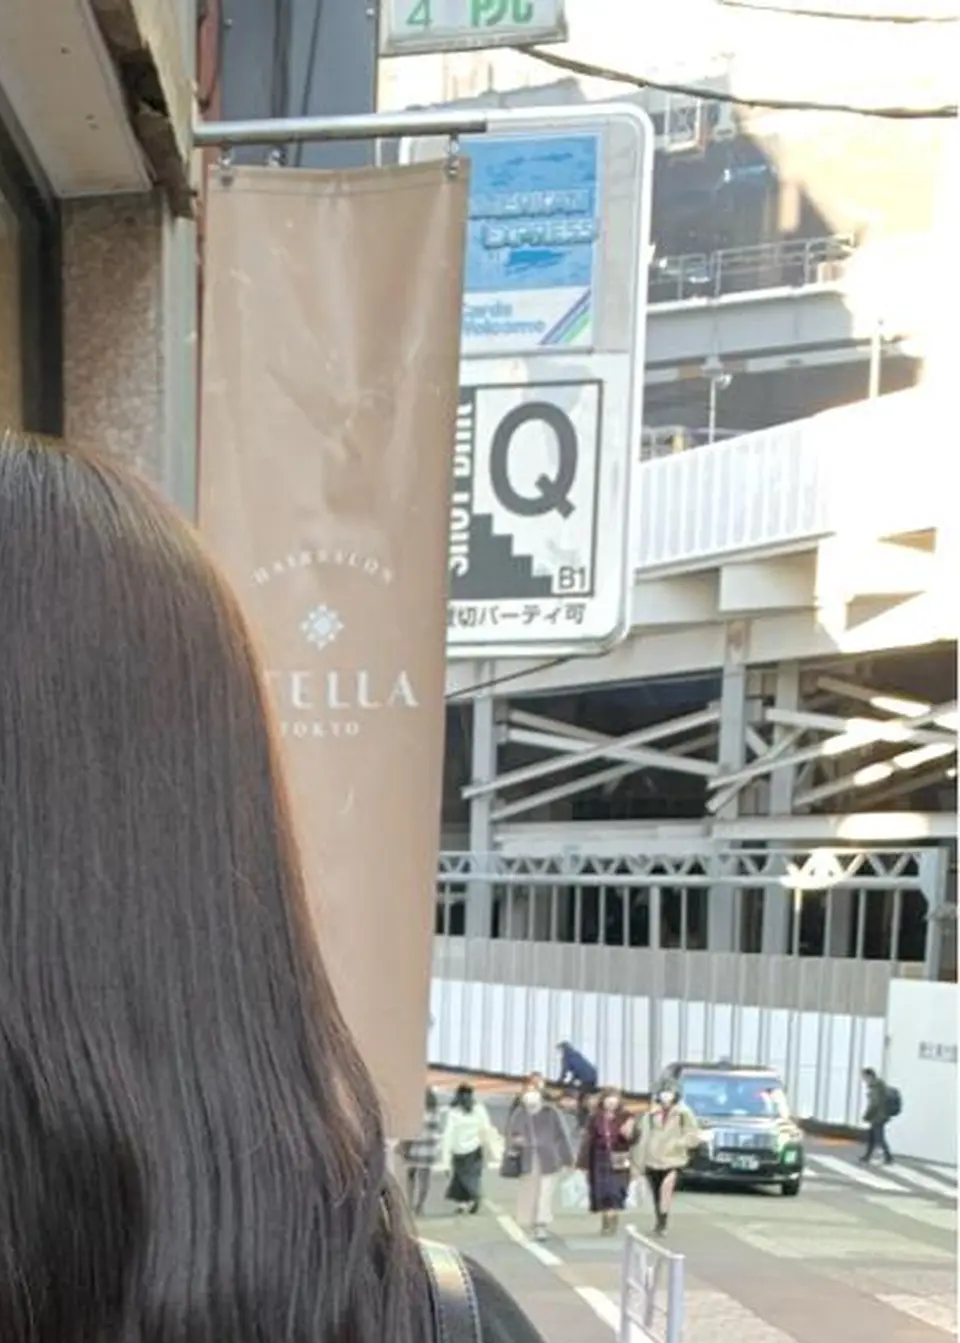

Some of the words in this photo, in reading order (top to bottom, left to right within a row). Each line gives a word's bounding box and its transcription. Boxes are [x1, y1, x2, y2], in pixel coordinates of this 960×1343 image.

[489, 400, 578, 520] Q
[557, 565, 587, 590] B1
[264, 669, 419, 710] TELLA
